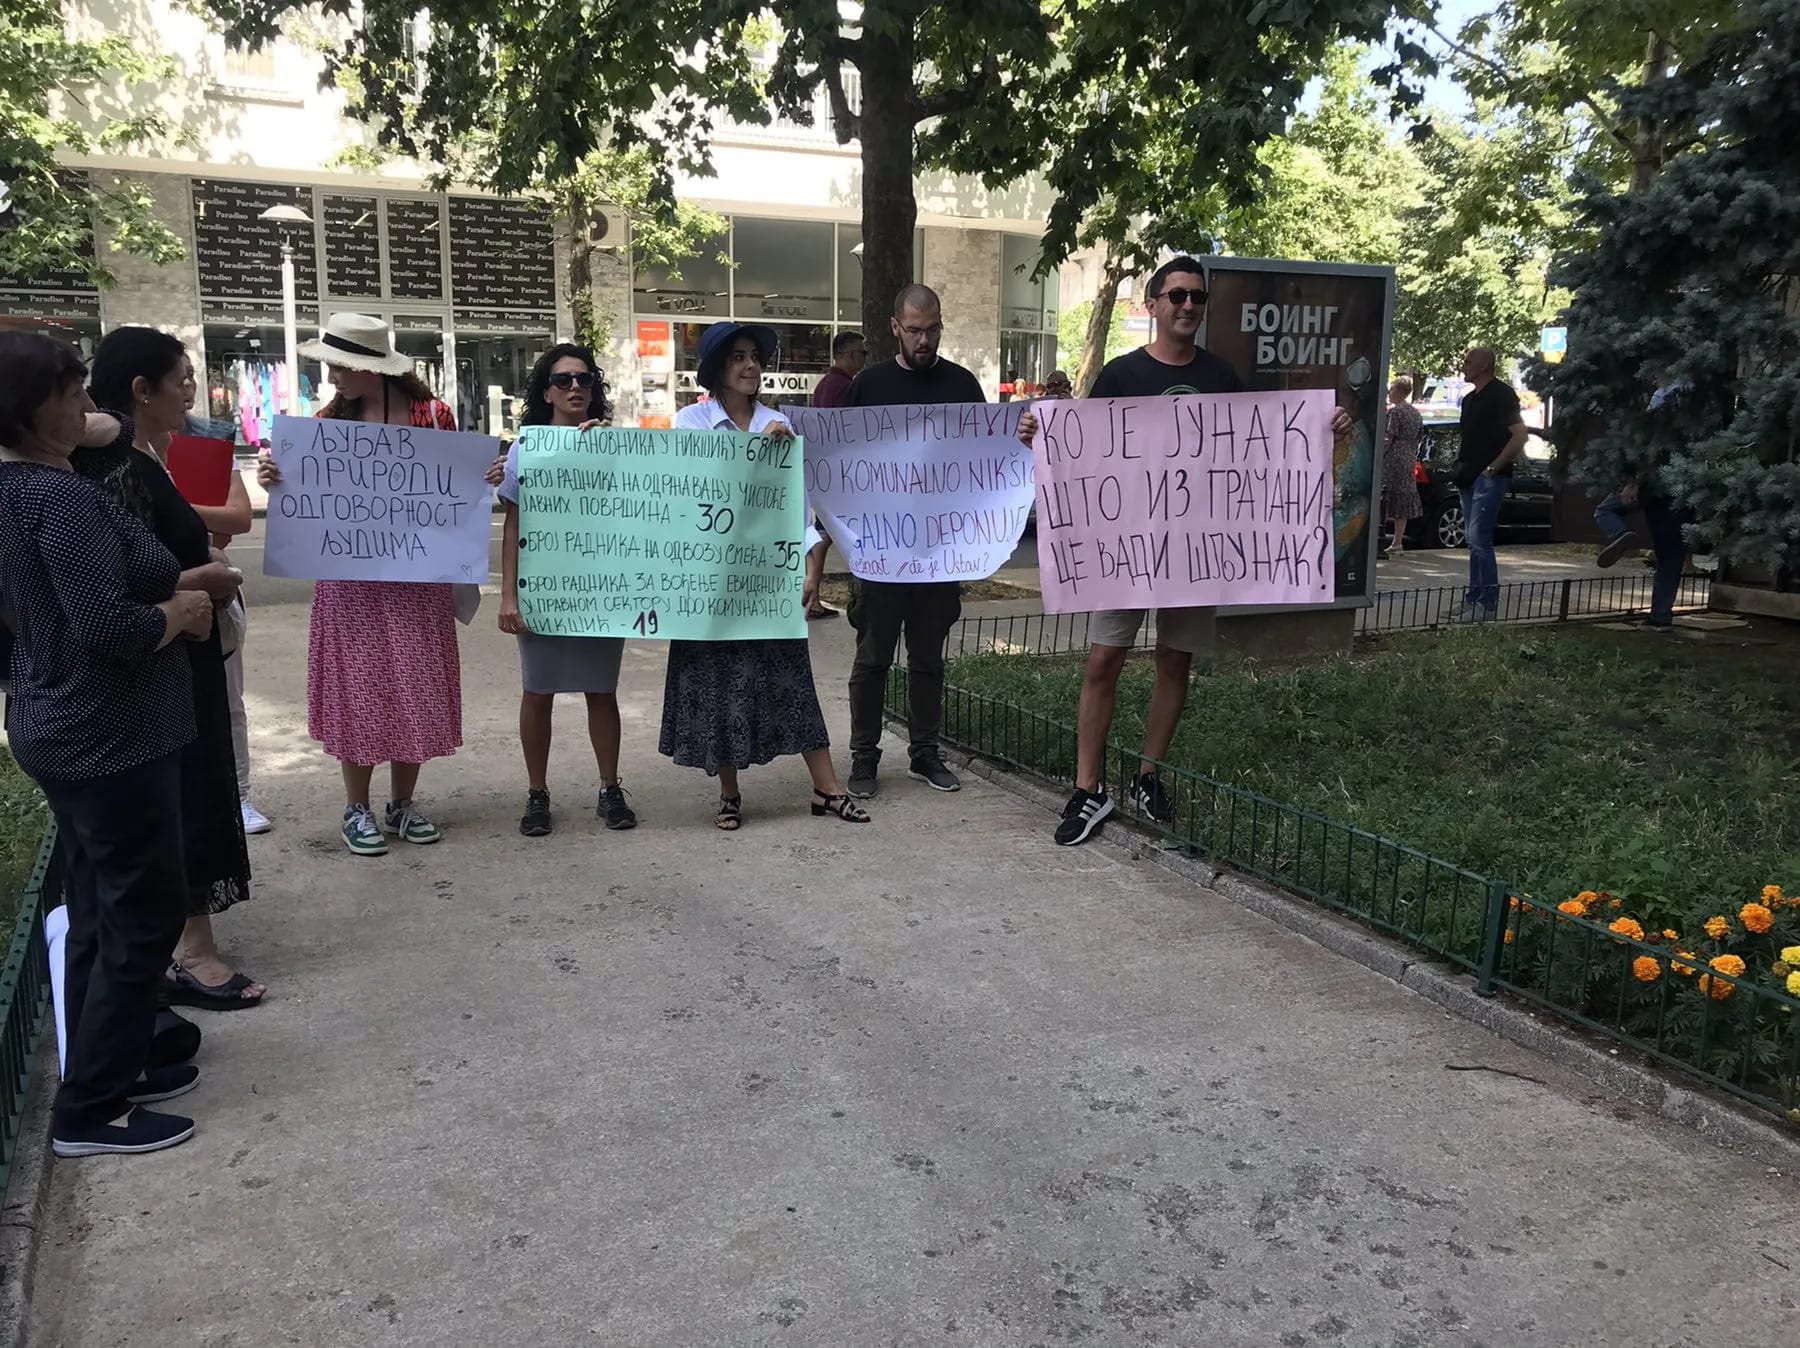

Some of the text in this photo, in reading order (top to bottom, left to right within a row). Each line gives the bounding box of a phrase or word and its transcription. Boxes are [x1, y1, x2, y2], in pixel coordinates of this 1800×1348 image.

[214, 185, 246, 194] Paradiso
[255, 188, 287, 197] Paradiso
[236, 200, 268, 208] Paradiso
[323, 206, 353, 214] Paradiso
[465, 202, 493, 210] Paradiso
[216, 211, 248, 219] Paradiso
[484, 215, 511, 223] Paradiso
[197, 222, 229, 231] Paradiso
[238, 225, 269, 233] Paradiso
[325, 230, 355, 238] Paradiso
[466, 226, 494, 234] Paradiso
[218, 236, 250, 245] Paradiso
[344, 243, 374, 251] Paradiso
[485, 239, 512, 247] Paradiso
[199, 248, 271, 258] Paradiso Paradiso
[220, 261, 251, 269] Paradiso
[485, 262, 512, 270] Paradiso
[201, 273, 232, 281] Paradiso
[221, 286, 253, 294] Paradiso
[9, 307, 43, 315] Paradiso
[53, 308, 88, 316] Paradiso
[223, 302, 254, 310] Paradiso
[1240, 303, 1338, 334] БОИНГ
[1549, 333, 1561, 349] P
[1256, 336, 1354, 366] БОИНГ
[863, 407, 897, 442] DA
[1039, 397, 1312, 465] КО ЈЕ ЈУНАК
[311, 422, 415, 459] ЉУБАВ
[525, 428, 560, 452] БРОЈ
[563, 429, 655, 456] СТАНОВНИКА
[660, 433, 669, 455] У
[301, 455, 460, 499] ПРИРОДИ
[840, 457, 960, 494] KOMUNALNO
[524, 468, 554, 488] БРОЈ
[557, 468, 618, 492] РАДНИКА
[622, 472, 640, 492] НА
[738, 481, 787, 510] ЧИСТОЋЕ
[1042, 468, 1331, 530] ШТО ИЗ ГРАЧАНИ-
[280, 493, 467, 528] ОДГОВОРНОСТ
[522, 494, 571, 513] ЈАВНИХ
[580, 496, 671, 524] ПОВРШИНА
[696, 504, 734, 534] 30
[320, 529, 428, 560] ЉУДИМА
[528, 531, 559, 552] БРОЈ
[565, 531, 640, 559] РАДНИКА
[645, 538, 660, 558] НА
[663, 541, 722, 566] ОДВОЗУ
[725, 543, 767, 567] СМЕЋА
[774, 540, 802, 571] 35
[927, 557, 941, 578] je
[943, 549, 990, 575] Ustav?
[1050, 526, 1329, 595] ЦЕ ВАДИ ШЉУНАК?
[528, 575, 557, 593] БРОЈ
[562, 573, 630, 594] РАДНИКА
[635, 572, 655, 591] ЗА
[522, 599, 533, 615] У
[537, 597, 598, 613] ПРАВНОМ
[604, 596, 670, 613] СЕКТОРУ
[708, 597, 793, 618] КОМУНАЛНО
[525, 615, 610, 634] НИКШИЋ
[632, 609, 658, 637] 19
